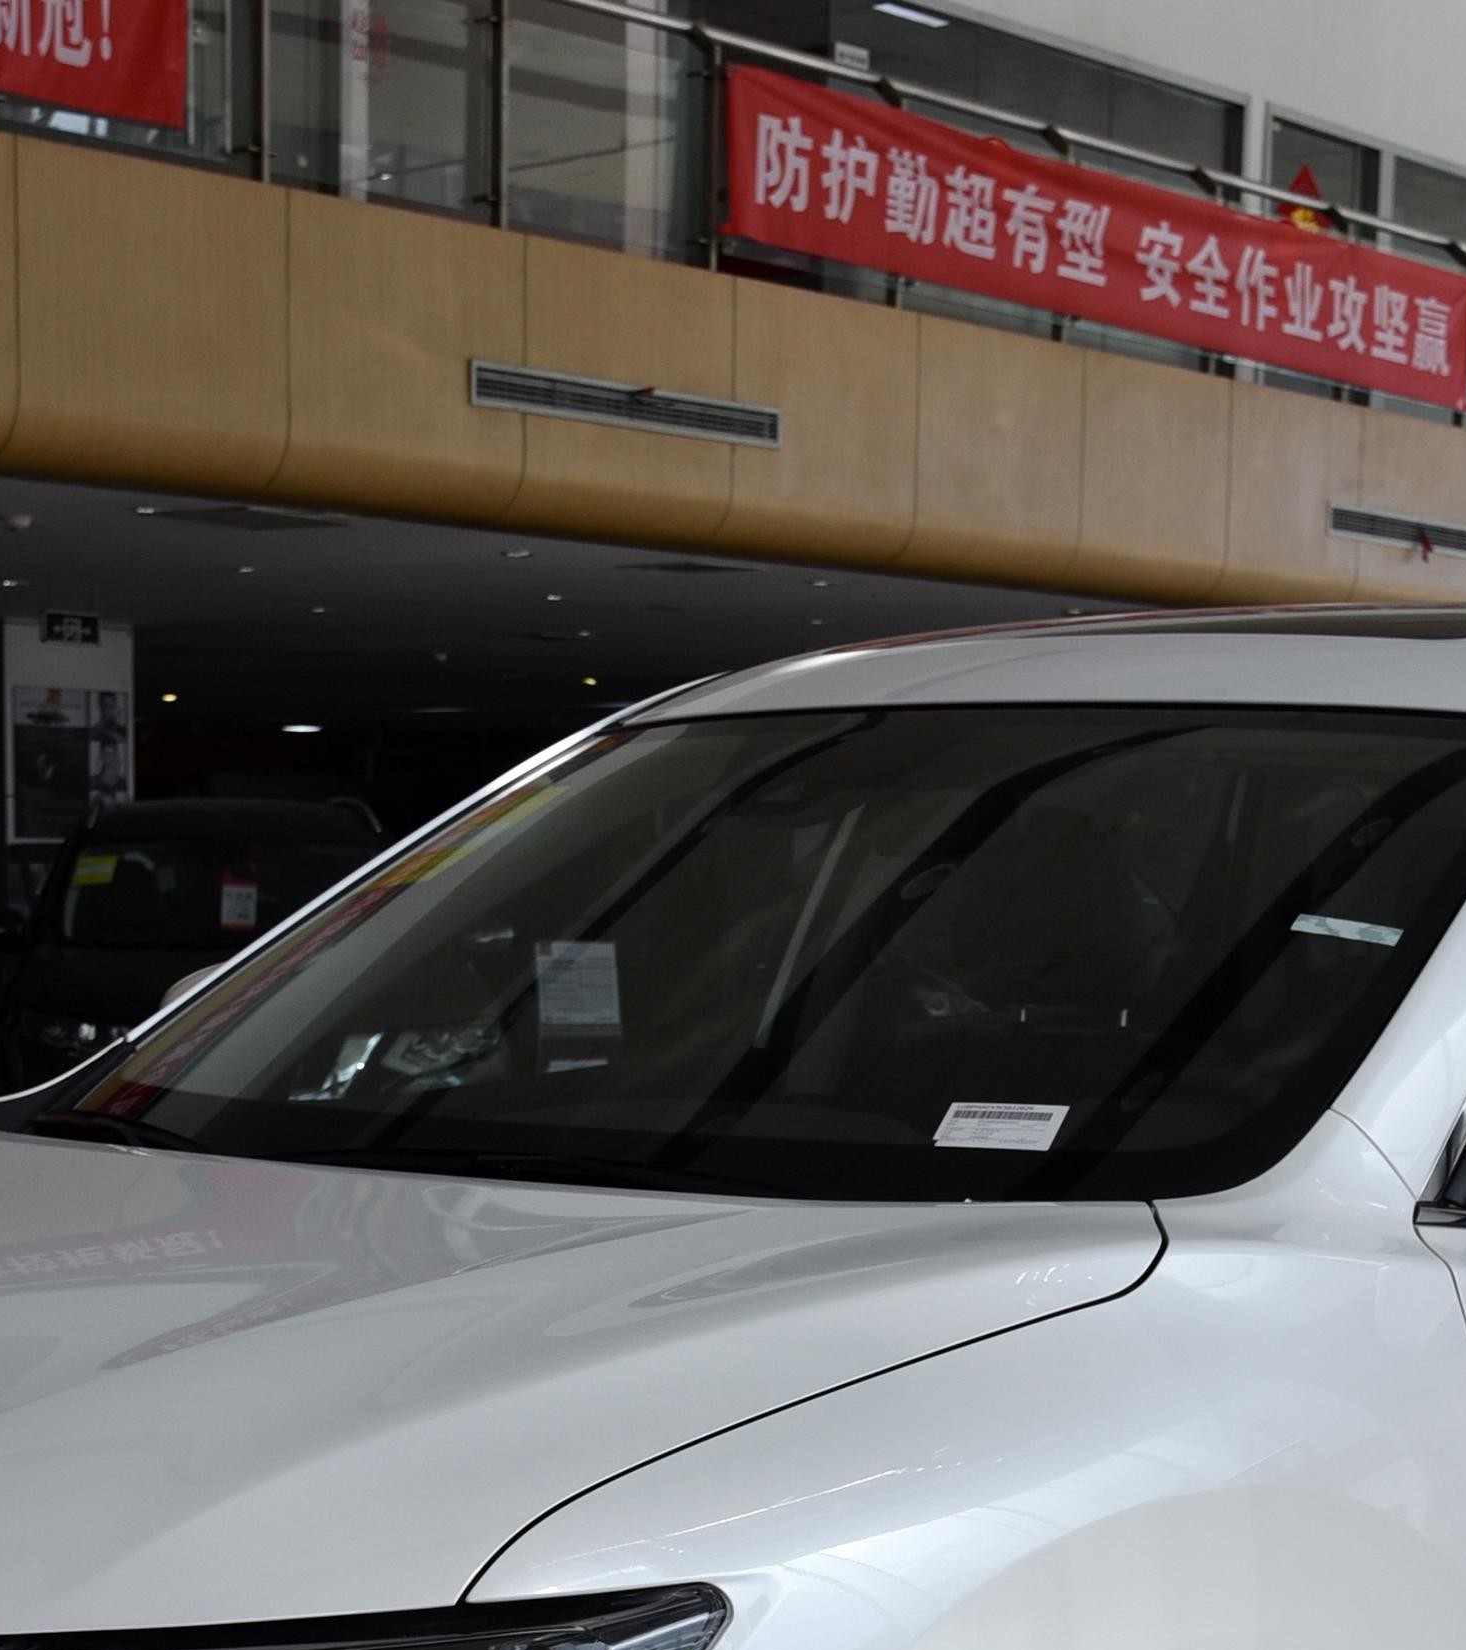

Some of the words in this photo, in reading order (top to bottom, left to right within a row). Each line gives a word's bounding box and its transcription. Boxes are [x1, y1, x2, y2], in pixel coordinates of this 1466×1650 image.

[755, 113, 1111, 287] 防护勤超有型
[1135, 220, 1452, 377] 安全作业攻坚赢
